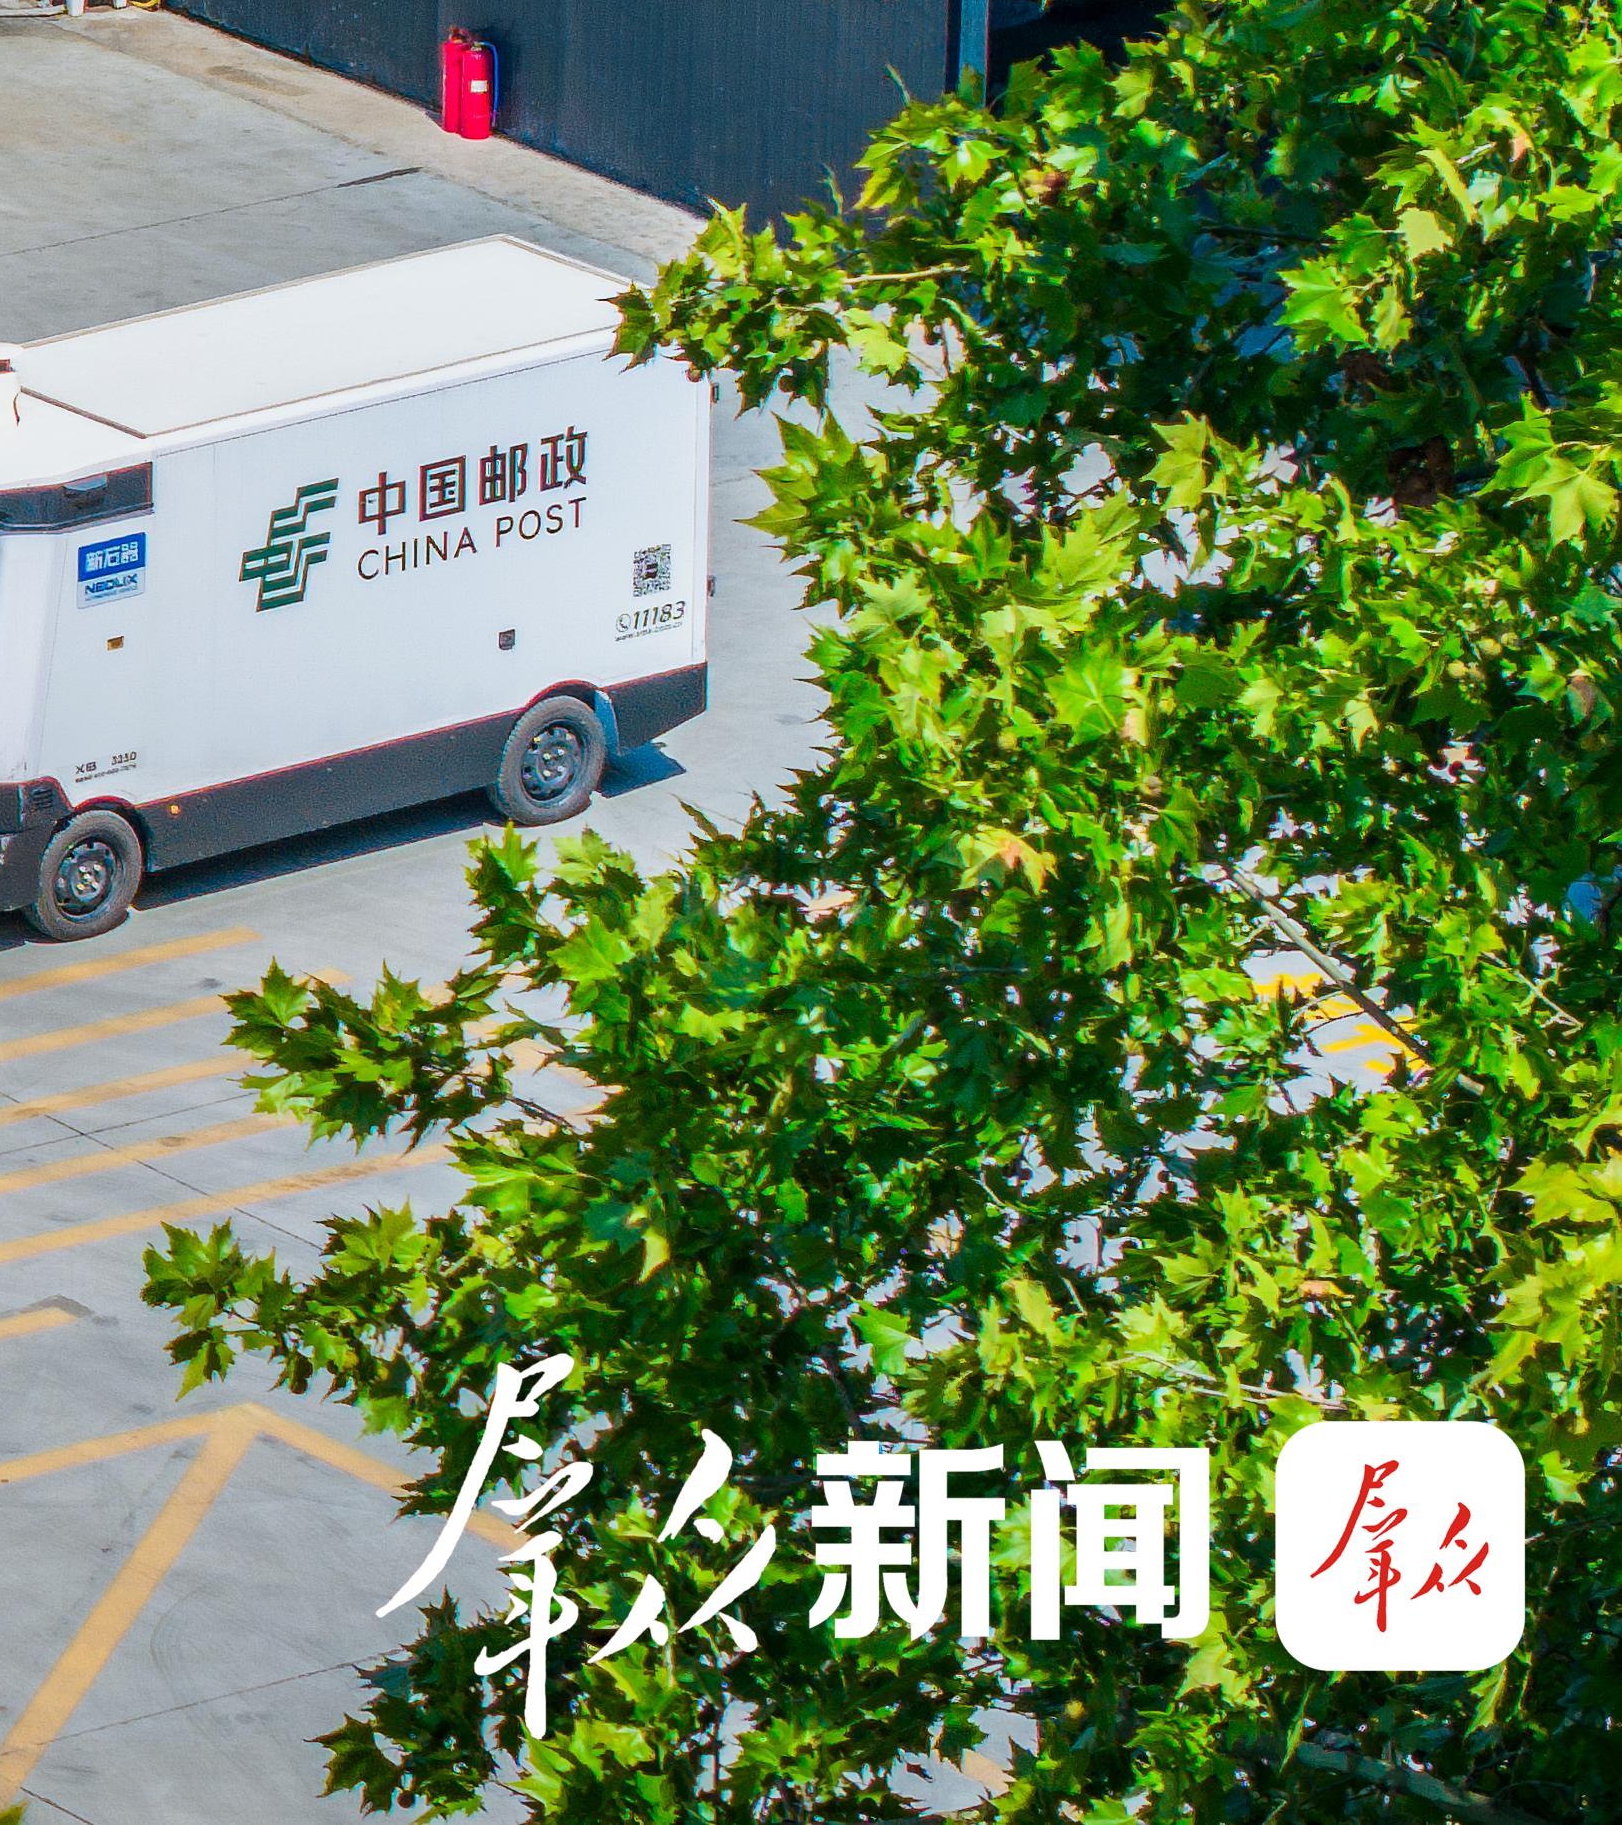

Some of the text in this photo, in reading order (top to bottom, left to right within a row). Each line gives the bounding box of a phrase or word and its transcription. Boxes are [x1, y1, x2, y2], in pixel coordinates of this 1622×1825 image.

[357, 424, 589, 536] 中国邮政
[86, 541, 139, 573] 新石器
[357, 496, 588, 580] CHINA POST
[634, 600, 686, 630] 11183
